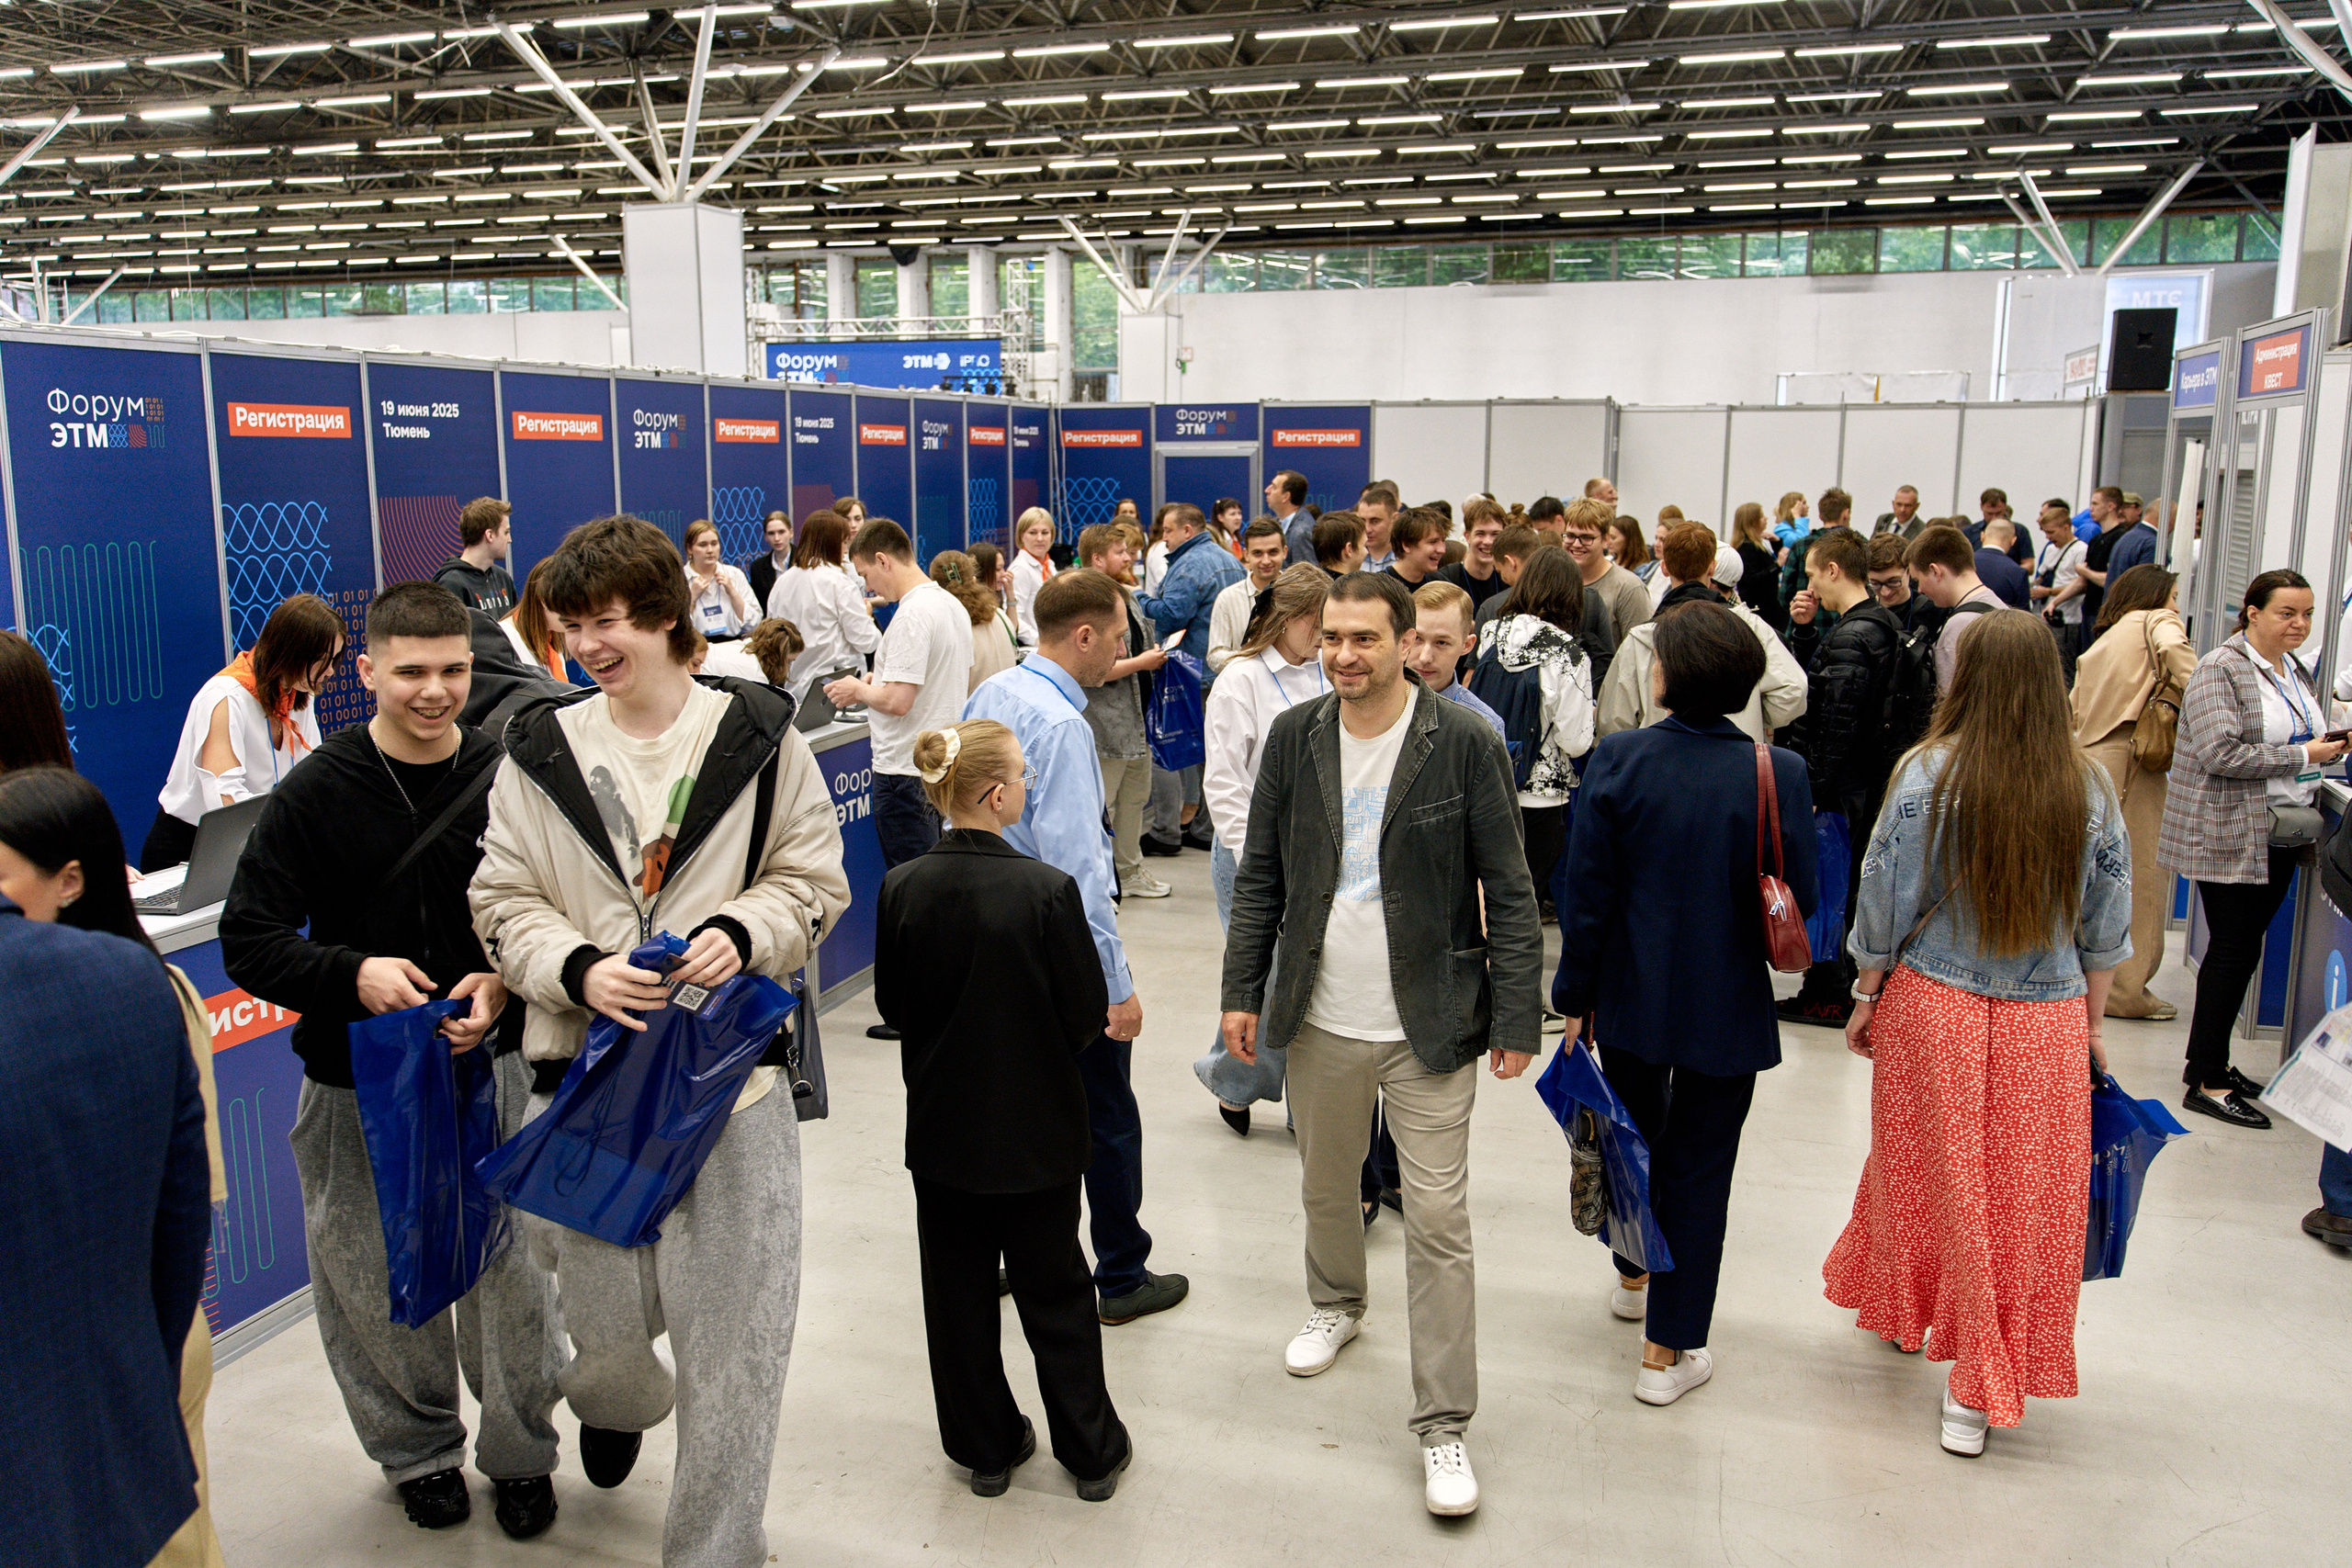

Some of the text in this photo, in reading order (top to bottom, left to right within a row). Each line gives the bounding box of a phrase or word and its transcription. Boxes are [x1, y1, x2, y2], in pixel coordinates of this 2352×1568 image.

[903, 355, 933, 368] ЭТМ
[2255, 342, 2298, 364] Администрация
[775, 352, 838, 376] Форум
[2180, 372, 2200, 393] Карьера
[2205, 367, 2218, 387] ЭТМ
[2263, 371, 2283, 389] КВЕСТ
[47, 388, 144, 423] Форум
[380, 400, 459, 418] 19 июня 2025
[235, 406, 345, 434] Регистрация
[517, 414, 598, 436] Регистрация
[633, 408, 678, 431] Форум
[794, 416, 802, 428] 19
[819, 417, 834, 429] 2025
[1176, 409, 1227, 424] Форум
[49, 422, 108, 448] ЭТМ
[382, 422, 431, 439] Тюмень
[718, 421, 776, 440] Регистрация
[795, 432, 820, 444] Тюмень
[862, 425, 904, 442] Регистрация
[922, 420, 949, 438] Форум
[970, 428, 1003, 443] Регистрация
[1176, 423, 1205, 435] ЭТМ
[1277, 431, 1356, 444] Регистрация
[634, 431, 662, 449] ЭТМ
[922, 436, 938, 450] ЭТМ
[1065, 432, 1137, 445] Регистрация
[834, 768, 872, 796] Фор
[837, 793, 870, 827] ЭТМ
